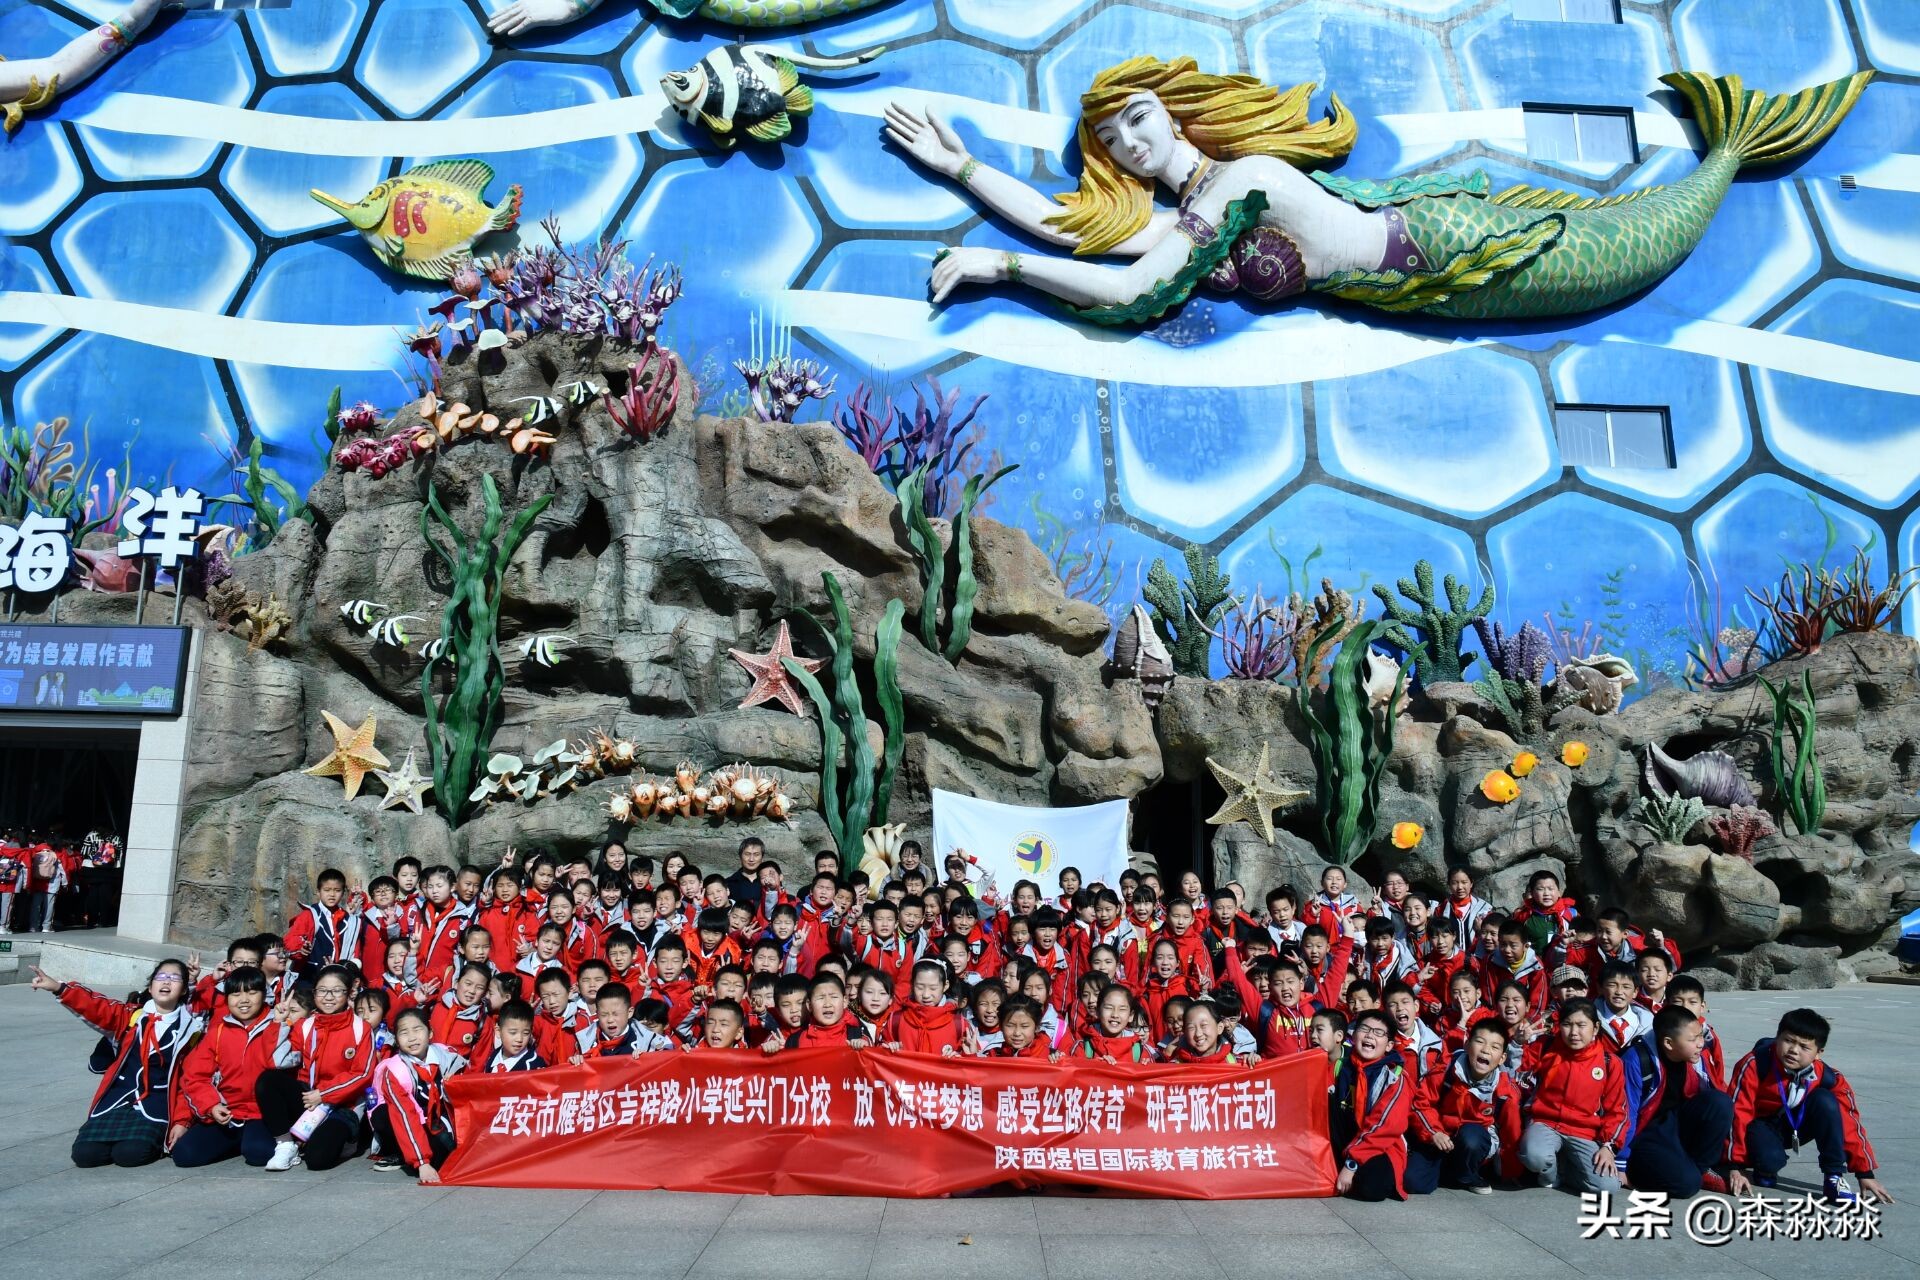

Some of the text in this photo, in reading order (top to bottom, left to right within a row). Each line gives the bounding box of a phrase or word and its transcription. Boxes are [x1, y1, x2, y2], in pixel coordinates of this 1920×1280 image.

[0, 641, 154, 668] 为绿色发展作贡献
[1145, 1079, 1276, 1134] 研学旅行活动
[994, 1143, 1279, 1172] 陕西煜恒国际教育旅行社
